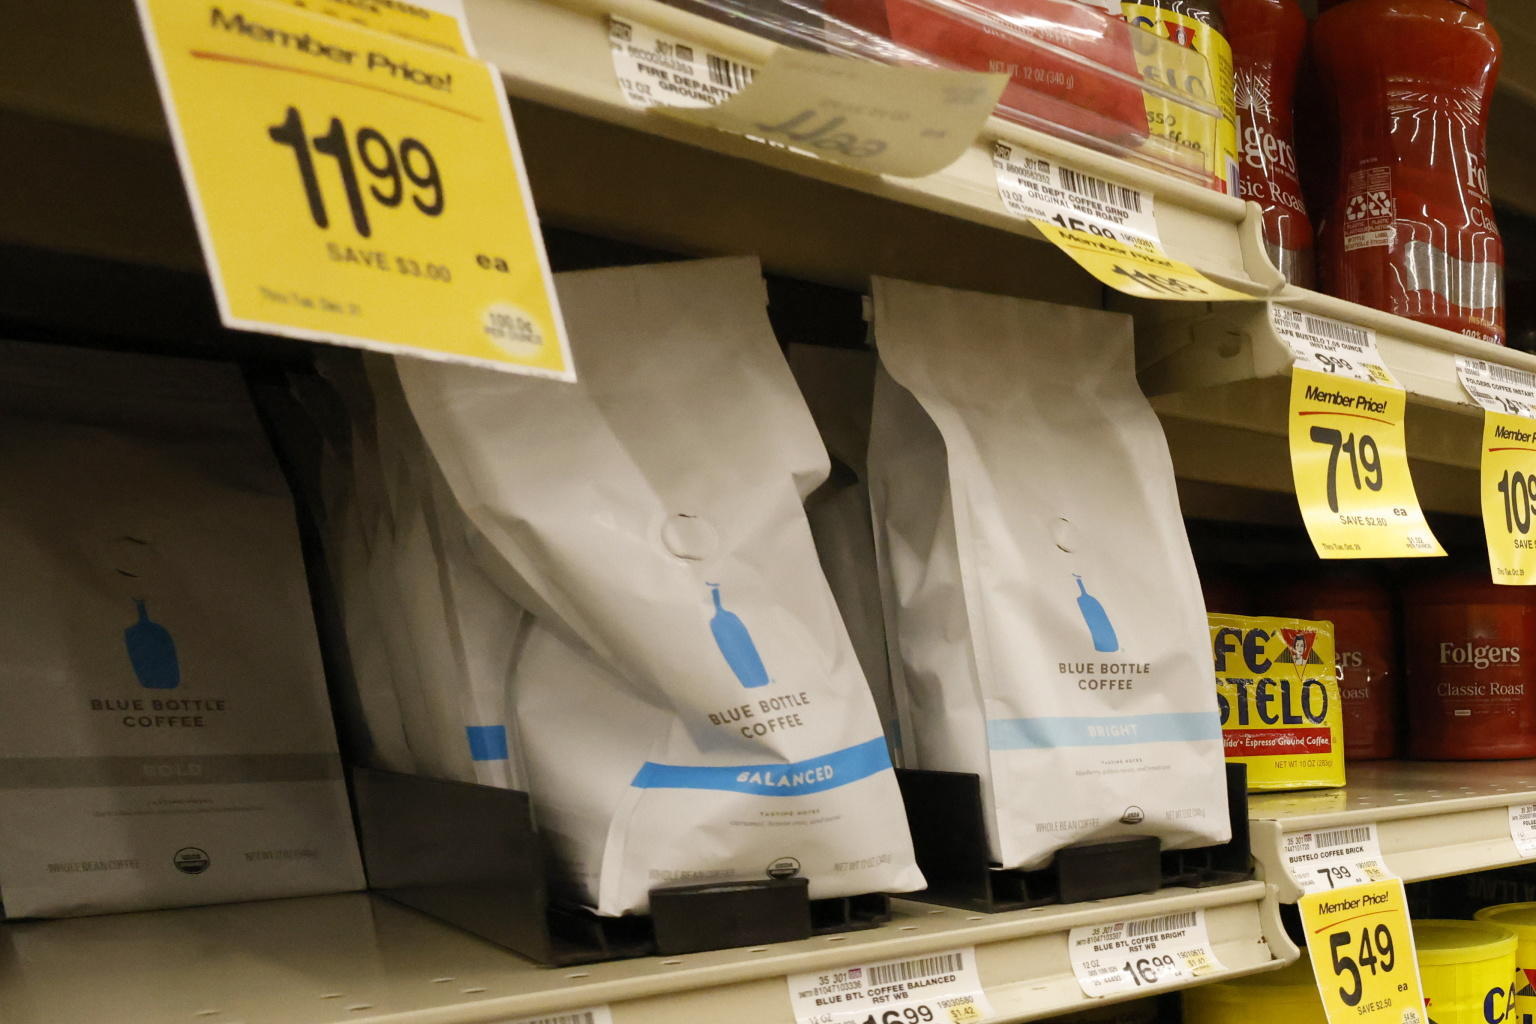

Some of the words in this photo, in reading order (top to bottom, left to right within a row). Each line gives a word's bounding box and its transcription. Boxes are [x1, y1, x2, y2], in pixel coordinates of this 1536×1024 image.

[209, 7, 359, 69] Member
[367, 49, 455, 94] Price!
[1018, 178, 1039, 192] FIRE
[1042, 185, 1065, 199] DEPT
[1069, 194, 1103, 211] COFFEE
[1106, 206, 1129, 219] GRND
[1028, 190, 1070, 209] ORIGINAL
[1073, 204, 1093, 216] MED
[1095, 212, 1124, 225] ROAST
[325, 242, 394, 274] SAVE
[395, 255, 452, 284] $3.00
[475, 252, 510, 274] ea
[1305, 385, 1354, 408] Member
[1356, 396, 1387, 414] Price!
[1495, 425, 1531, 444] Member
[1339, 515, 1364, 526] SAVE
[1366, 516, 1388, 527] $2.80
[1393, 508, 1407, 517] ea
[1514, 539, 1533, 549] SAVE
[1439, 641, 1521, 668] Folgers
[1058, 661, 1096, 675] BLUE
[1100, 661, 1152, 675] BOTTLE
[1078, 678, 1134, 691] COFFEE
[1437, 682, 1486, 697] Classic
[1490, 682, 1525, 696] Roast
[90, 700, 146, 712] BLUE
[152, 699, 226, 712] BOTTLE
[709, 704, 754, 728] BLUE
[758, 691, 811, 718] BOTTLE
[122, 715, 205, 728] COFFEE
[740, 713, 804, 739] COFFEE
[1087, 722, 1139, 738] BRIGHT
[736, 763, 836, 789] BALANCED
[1289, 853, 1319, 864] BUSTELO
[1320, 849, 1344, 859] COFFEE
[1345, 846, 1364, 855] BRICK
[1319, 898, 1360, 915] Member
[1362, 891, 1389, 907] Price!
[1094, 943, 1113, 952] BLUE
[1116, 940, 1129, 949] BTL
[1132, 934, 1159, 945] COFFEE
[1161, 930, 1186, 941] BRIGHT
[1357, 1004, 1375, 1016] SAVE
[1376, 999, 1392, 1011] $2.50
[1397, 983, 1408, 992] ea
